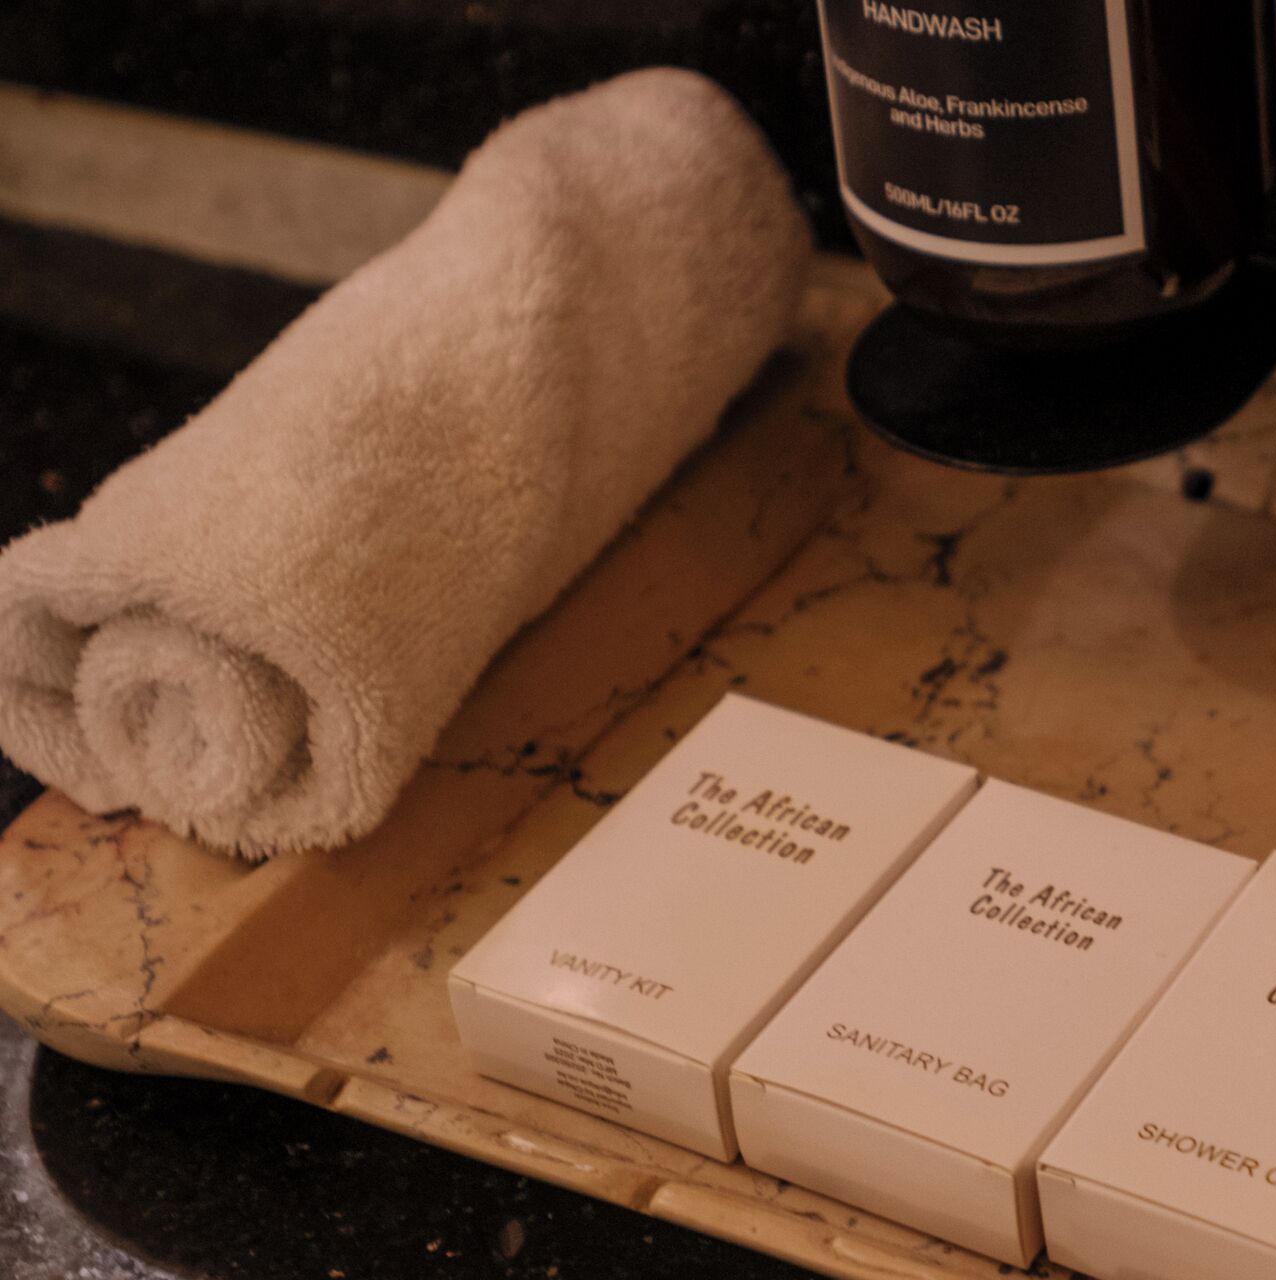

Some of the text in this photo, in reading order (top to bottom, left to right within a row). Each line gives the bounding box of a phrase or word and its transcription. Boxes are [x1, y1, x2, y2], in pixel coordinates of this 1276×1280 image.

[890, 108, 984, 139] and Herbs
[899, 86, 943, 112] Aloe,
[947, 95, 1088, 119] Frankincense
[991, 204, 1020, 224] OZ
[670, 802, 816, 865] Collection
[687, 771, 851, 842] The African
[969, 896, 1094, 951] Collection
[981, 867, 1124, 930] The African
[549, 949, 675, 1000] VANITY KIT
[826, 1023, 1011, 1098] SANITARY BAG
[1138, 1122, 1260, 1176] SHOWER
